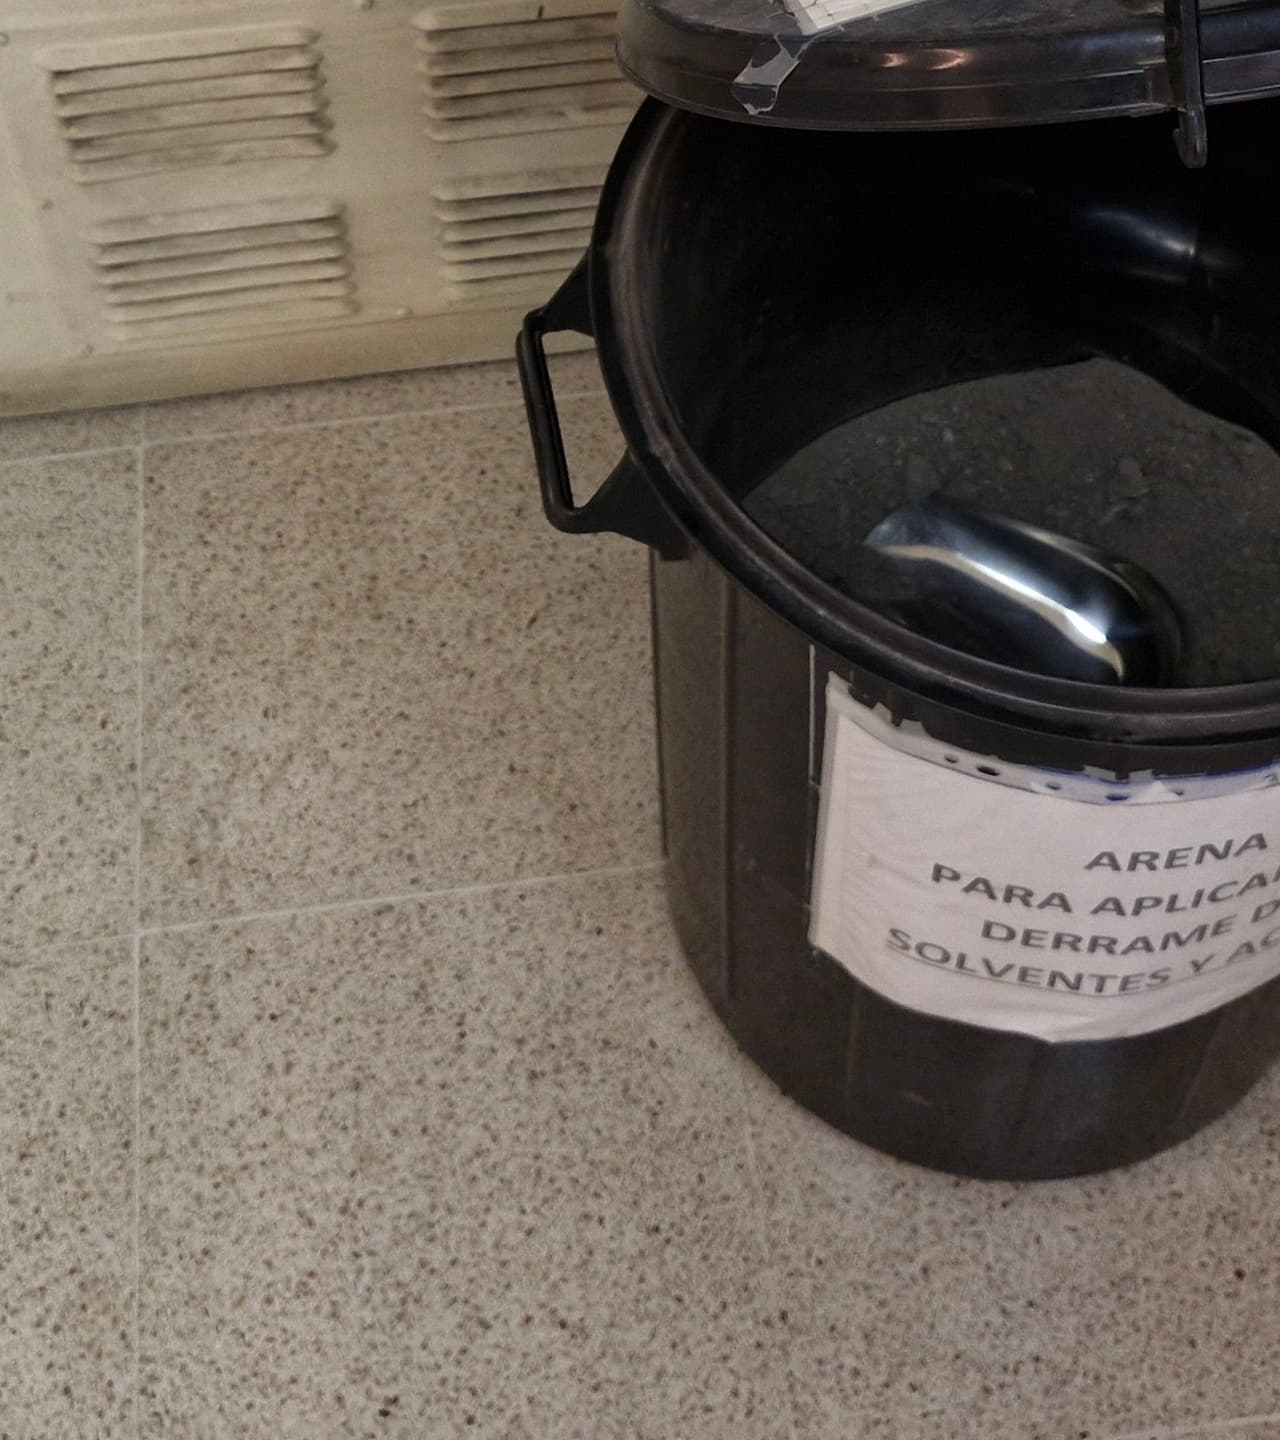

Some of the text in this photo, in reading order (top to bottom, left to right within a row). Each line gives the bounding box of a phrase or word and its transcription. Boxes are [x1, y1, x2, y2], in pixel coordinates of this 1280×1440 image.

[1084, 832, 1269, 873] ARENA
[930, 862, 1074, 914] PARA
[980, 913, 1238, 957] DERRAME
[885, 927, 1171, 996] SOLVENTES
[1189, 953, 1217, 973] Y
